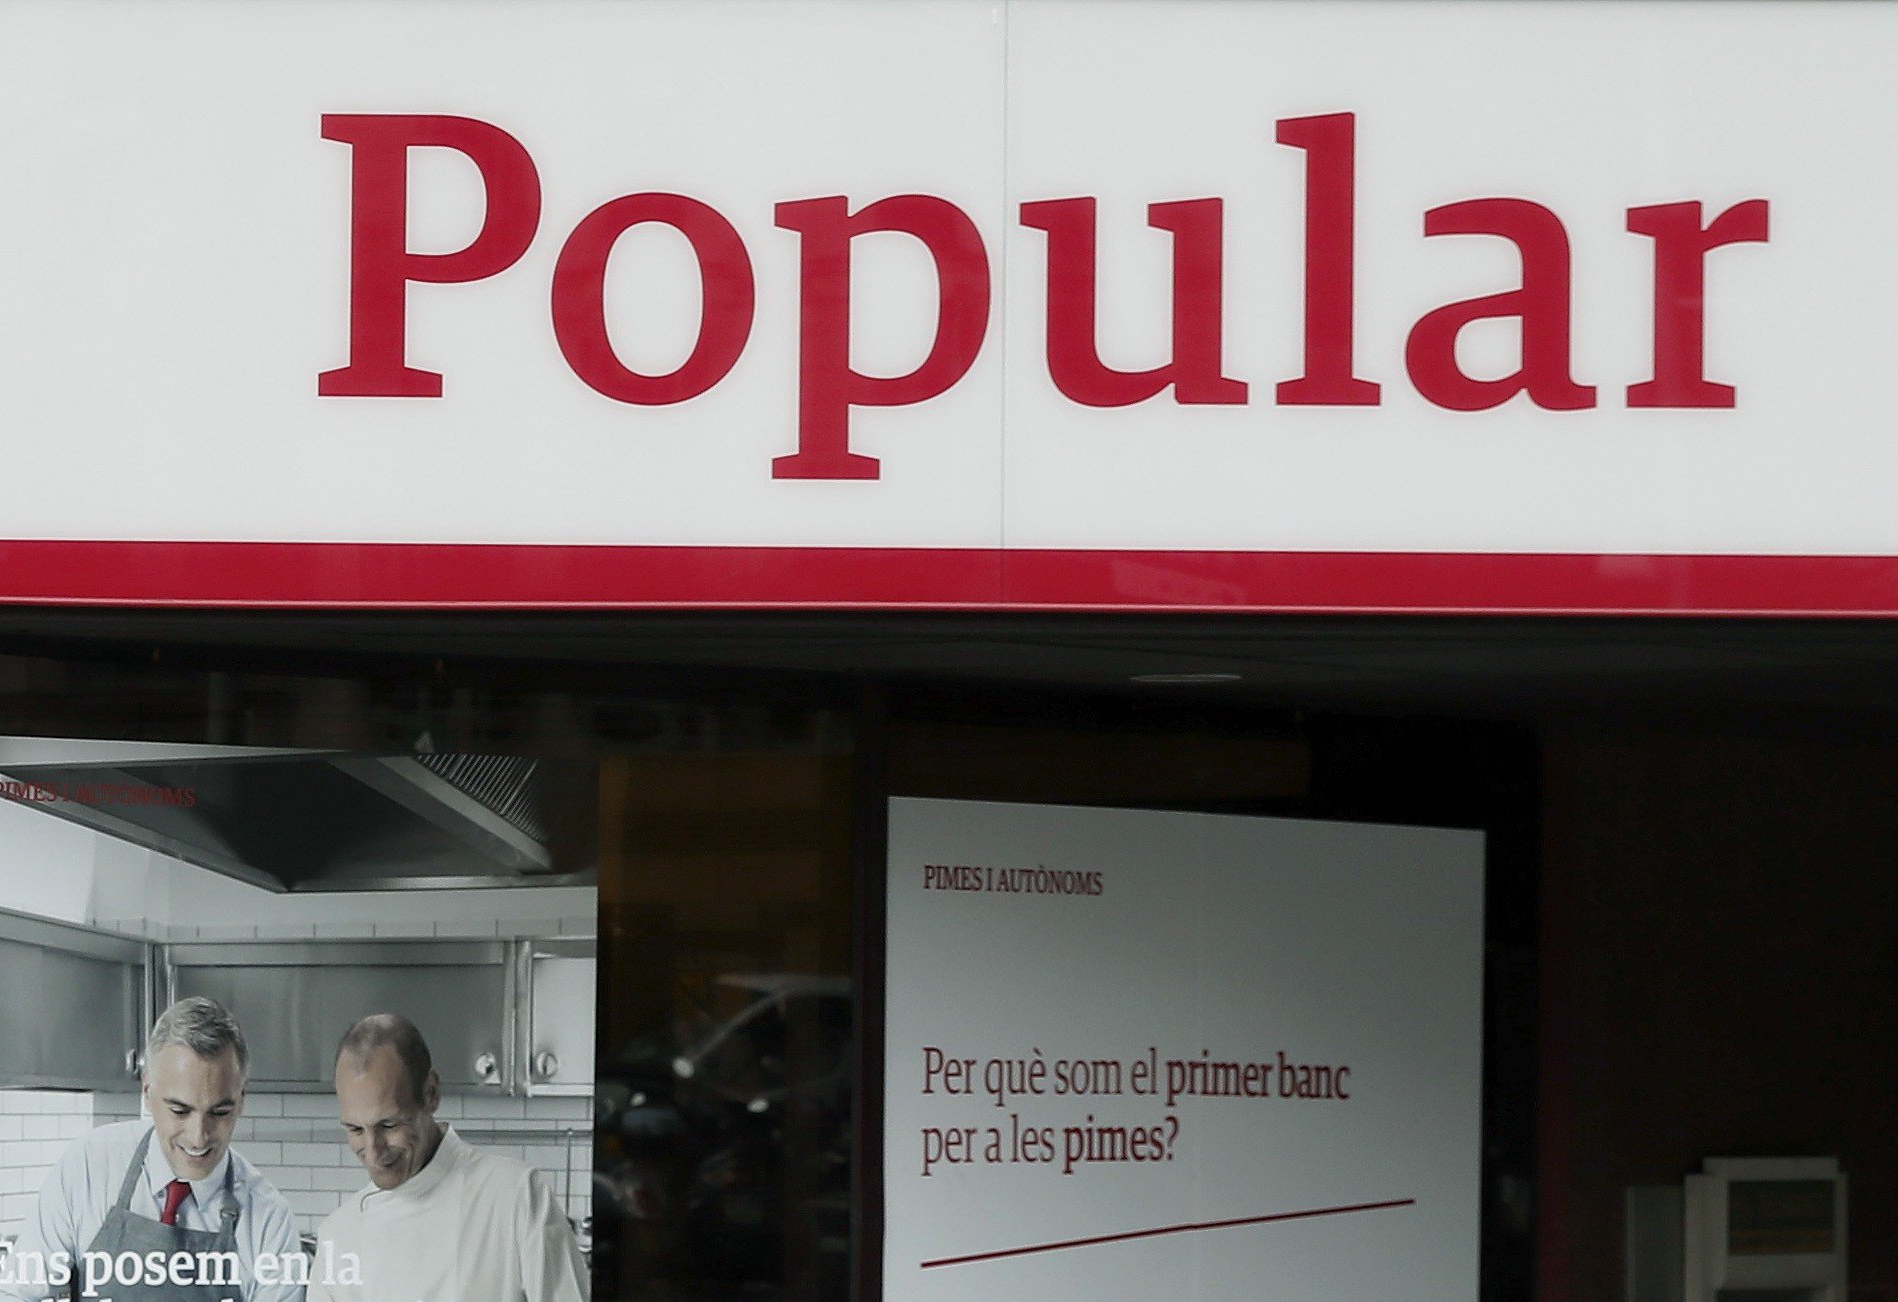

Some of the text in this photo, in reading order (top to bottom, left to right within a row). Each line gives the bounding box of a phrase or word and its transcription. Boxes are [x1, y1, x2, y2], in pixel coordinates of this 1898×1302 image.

[318, 112, 1769, 480] Popular
[924, 865, 1103, 898] PIMES I AUTÒNOMS
[923, 1047, 1351, 1106] Per què som el primer banc
[921, 1114, 1180, 1176] per a les pimes?
[82, 1249, 242, 1297] posem
[254, 1250, 312, 1286] en
[322, 1239, 363, 1286] la
